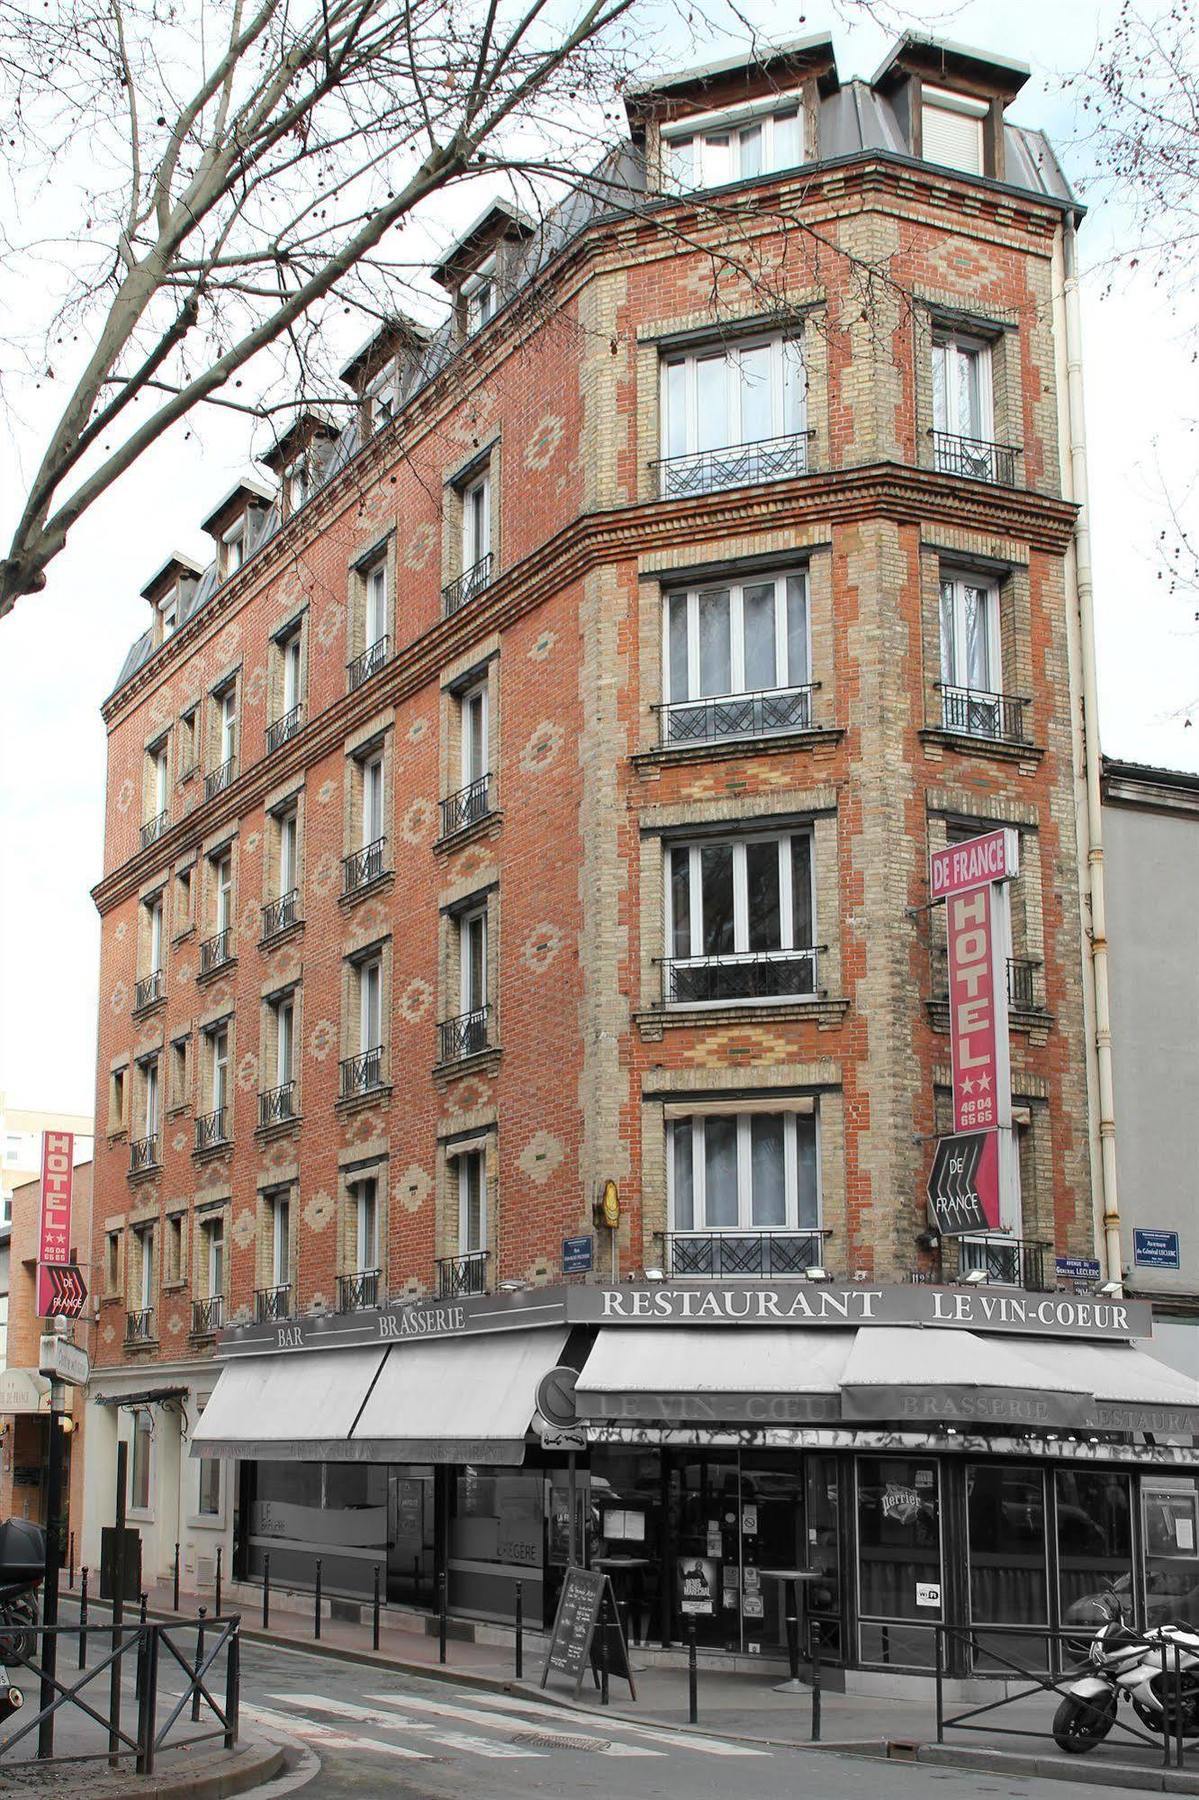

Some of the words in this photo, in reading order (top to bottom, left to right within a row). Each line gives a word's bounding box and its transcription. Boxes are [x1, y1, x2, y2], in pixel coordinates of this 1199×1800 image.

[934, 856, 950, 890] DE
[953, 838, 1004, 884] FRANCE
[954, 893, 990, 1070] HOTEL
[960, 1100, 975, 1114] 46
[977, 1096, 992, 1111] 04
[960, 1112, 976, 1126] 65
[977, 1109, 992, 1123] 65
[950, 1158, 964, 1174] DE
[45, 1135, 70, 1229] HOTEL
[936, 1193, 978, 1213] FRANCE
[63, 1278, 73, 1288] DE
[53, 1298, 82, 1308] FRANCE
[601, 1291, 882, 1317] RESTAURANT
[932, 1293, 974, 1320] LE
[980, 1297, 1129, 1329] VIN-COEUR
[379, 1306, 466, 1337] BRASSERIE
[277, 1326, 304, 1347] BAR
[600, 1396, 640, 1416] LE
[746, 1397, 840, 1419] CŒU
[901, 1397, 1049, 1420] BRASSERIE
